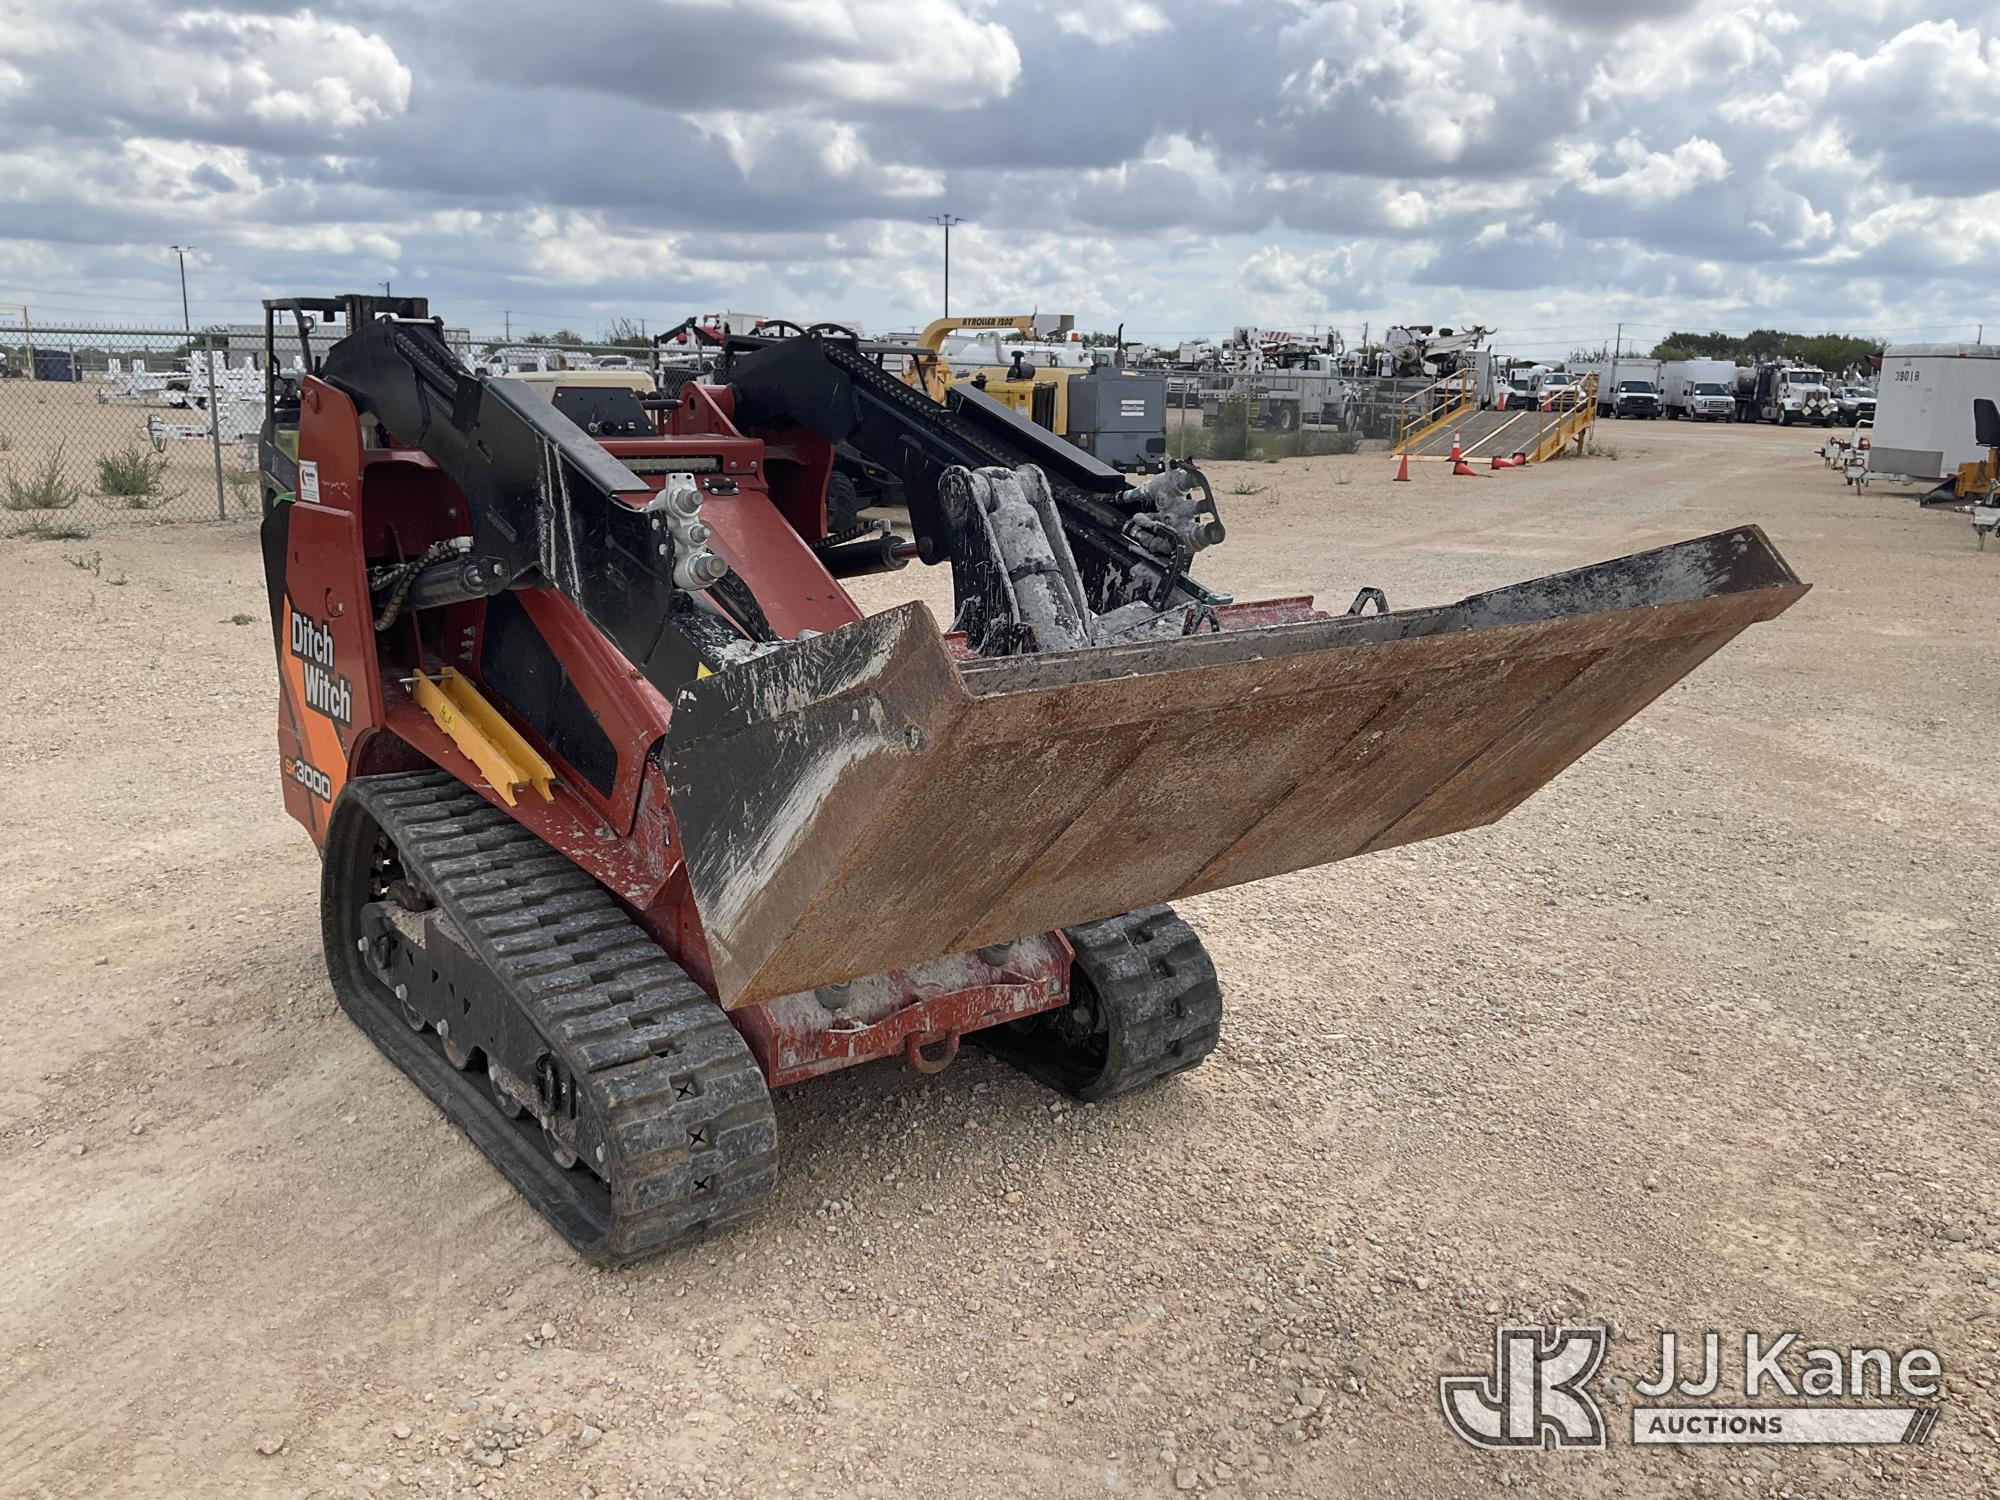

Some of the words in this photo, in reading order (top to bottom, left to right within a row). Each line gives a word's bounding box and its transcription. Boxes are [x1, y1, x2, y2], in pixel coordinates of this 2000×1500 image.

[997, 317, 1014, 326] 1200
[1895, 370, 1920, 381] 39018
[292, 611, 334, 668] Ditch
[304, 662, 351, 723] Witch
